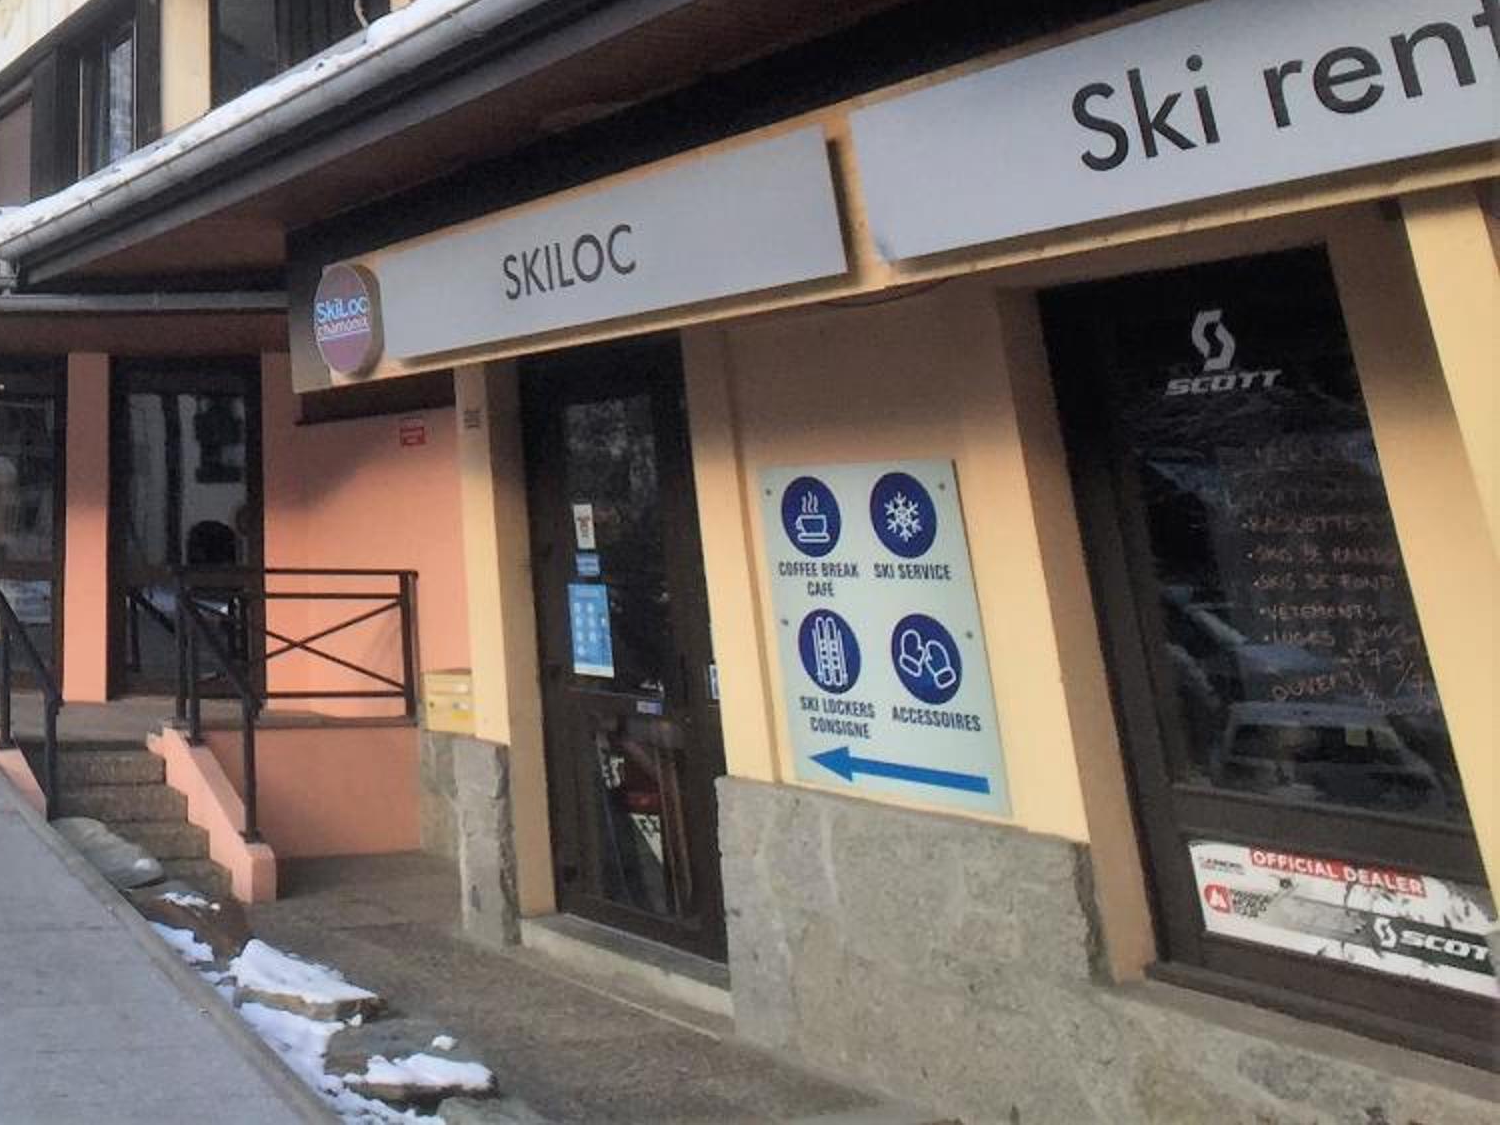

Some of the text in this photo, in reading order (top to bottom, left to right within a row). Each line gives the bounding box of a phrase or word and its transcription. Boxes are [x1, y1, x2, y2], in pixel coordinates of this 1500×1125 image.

[1072, 54, 1220, 171] Ski
[503, 224, 637, 300] SKILOC
[1165, 369, 1282, 395] SCOTT
[778, 562, 860, 578] COFFEE BREAK
[874, 563, 952, 580] SKI SERVICE
[823, 698, 876, 718] LOCKERS
[892, 706, 982, 733] ACCESSOIRES
[809, 716, 871, 739] CONSIGNE
[1253, 850, 1339, 879] OFFICIAL
[1343, 865, 1425, 893] DEALER
